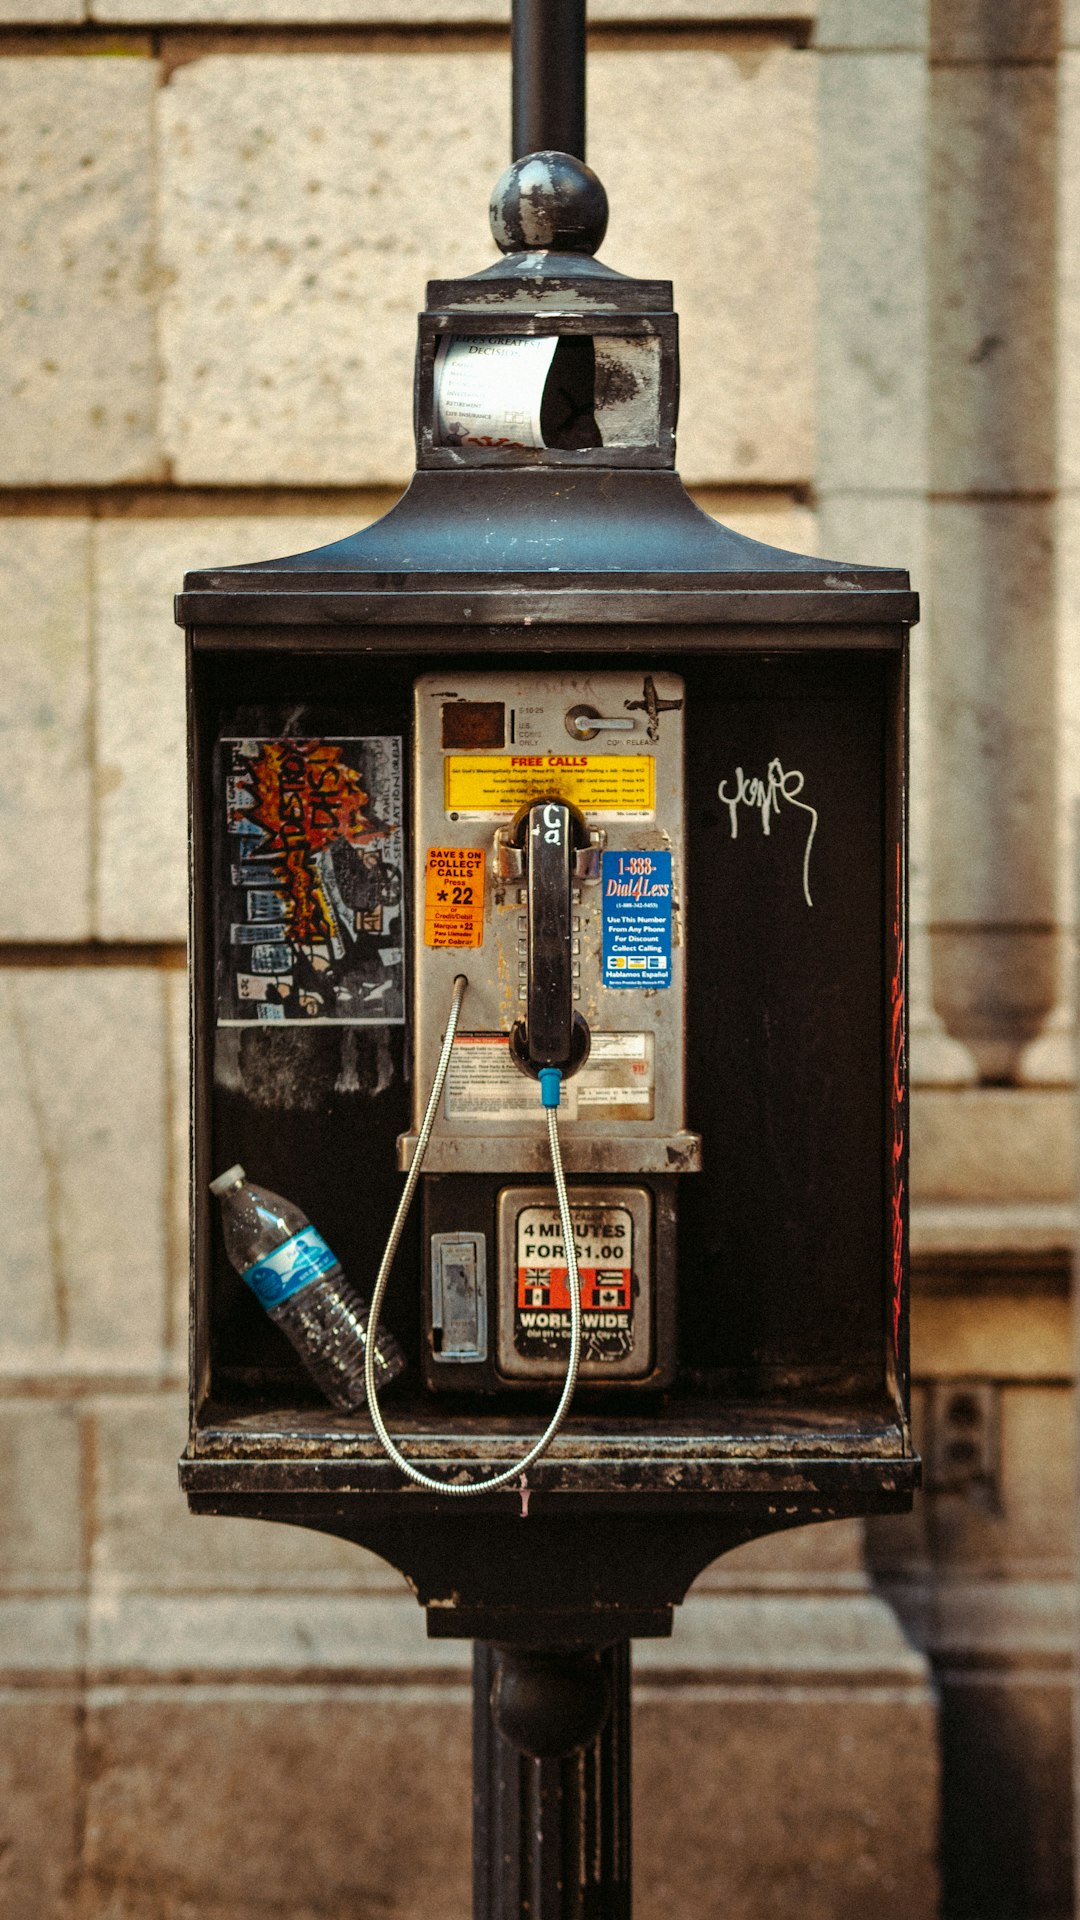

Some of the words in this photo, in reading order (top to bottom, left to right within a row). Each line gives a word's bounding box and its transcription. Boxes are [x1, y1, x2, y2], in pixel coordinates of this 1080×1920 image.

[459, 411, 492, 420] INSURANCE
[511, 757, 543, 767] FREE
[548, 757, 588, 767] CALLS
[430, 850, 456, 858] SAVE
[458, 851, 464, 859] $
[429, 859, 481, 869] COLLECT
[618, 857, 657, 875] 1-888-
[437, 869, 473, 878] CALLS
[444, 878, 466, 886] Press
[628, 926, 642, 934] Any
[638, 944, 662, 953] Calling
[606, 970, 640, 978] Hablamos
[525, 1224, 535, 1236] 4
[539, 1224, 626, 1237] MIUTES
[526, 1245, 564, 1258] FOR
[574, 1245, 624, 1258] $1.00
[520, 1313, 629, 1328] WORLWIDE
